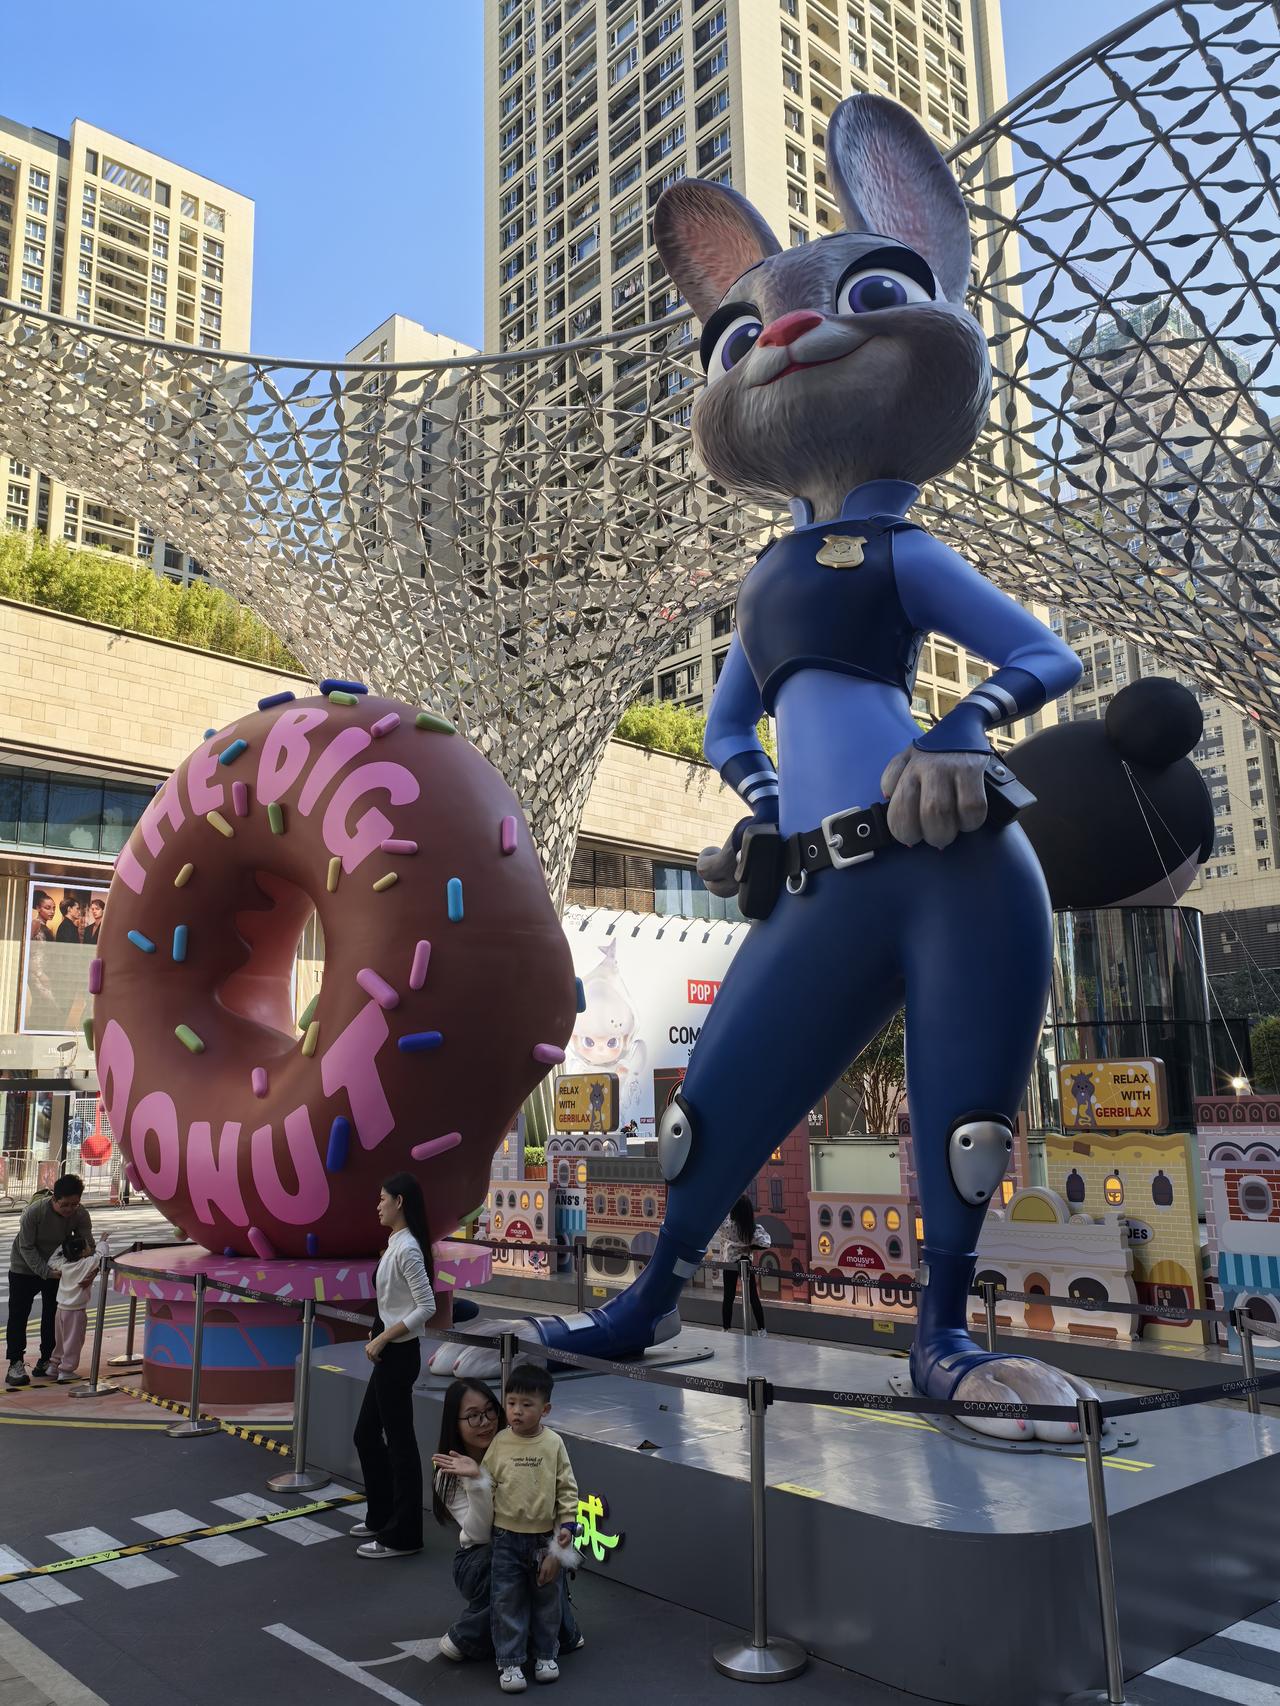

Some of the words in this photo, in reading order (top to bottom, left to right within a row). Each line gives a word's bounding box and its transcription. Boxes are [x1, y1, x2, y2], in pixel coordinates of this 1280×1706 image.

[257, 708, 421, 875] BIG
[690, 983, 711, 1001] POP
[1113, 1073, 1150, 1085] RELAX
[559, 1086, 580, 1095] RELAX
[1121, 1090, 1151, 1101] WITH
[559, 1100, 576, 1109] WITH
[97, 999, 397, 1226] DONUT
[1095, 1106, 1152, 1118] GERBILAX
[559, 1113, 591, 1123] GERBILAX
[846, 1256, 875, 1265] mousy's
